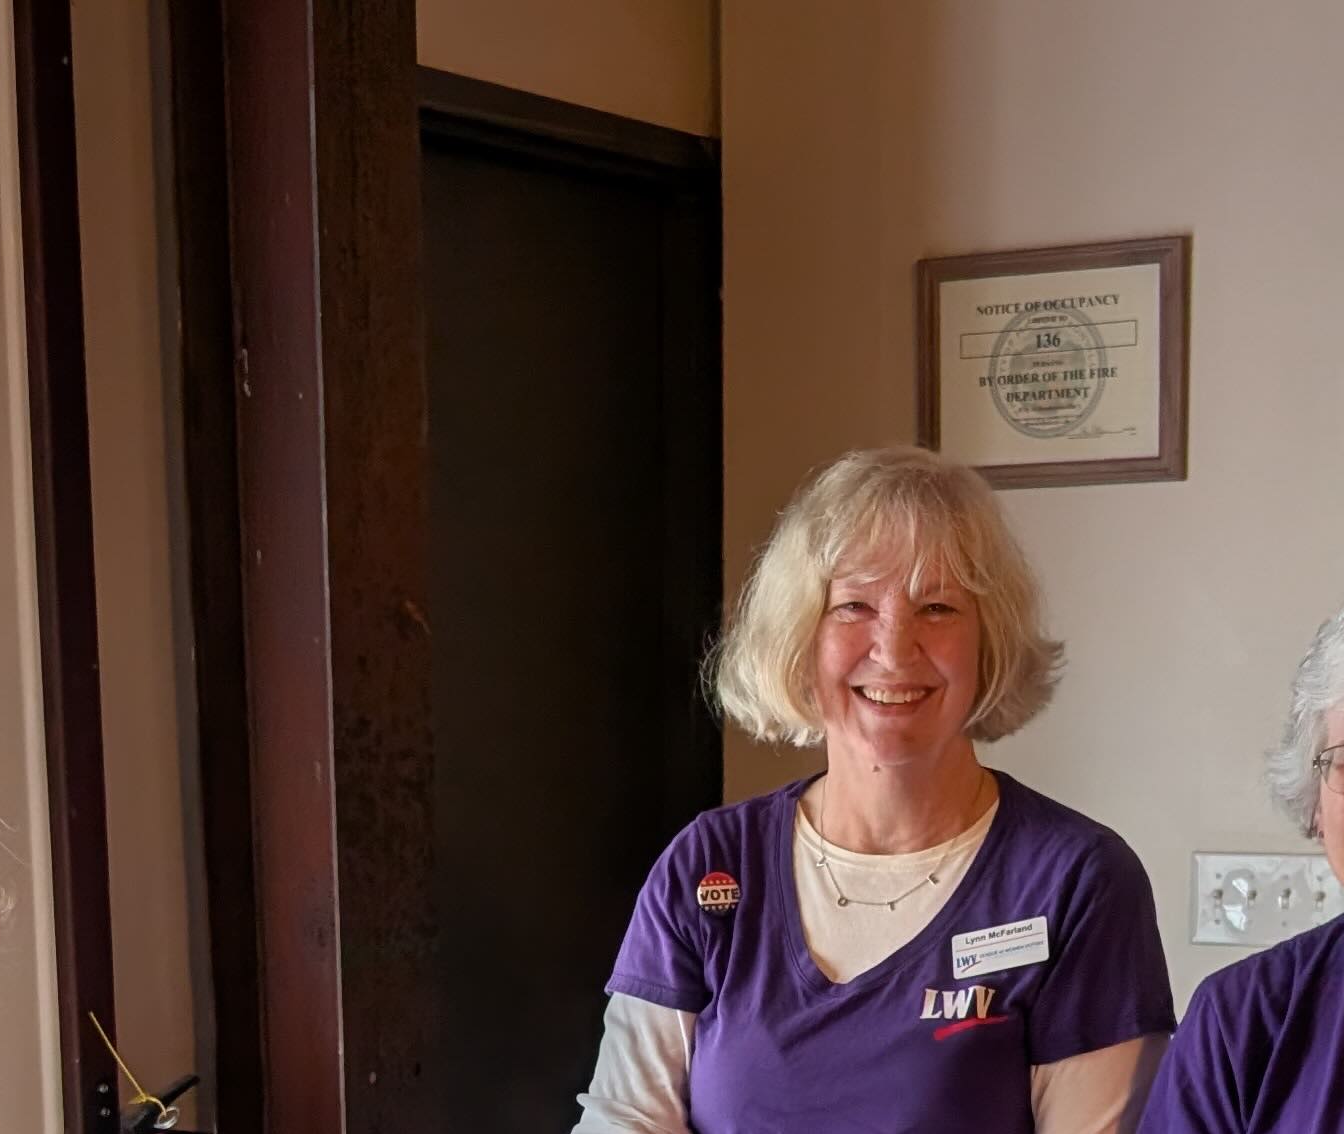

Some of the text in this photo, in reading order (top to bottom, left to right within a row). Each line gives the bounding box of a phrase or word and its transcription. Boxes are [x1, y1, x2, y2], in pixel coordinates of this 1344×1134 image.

[976, 294, 1120, 316] NOTICE OF OCCUPANCY
[1035, 333, 1060, 349] 136
[979, 367, 1118, 387] BY ORDER OF THE FIRE
[1006, 387, 1090, 402] DEPARTMENT
[700, 888, 739, 900] VOTE
[965, 924, 1032, 945] Lynn McFarland
[956, 953, 978, 968] LWV
[920, 985, 996, 1019] LWV
